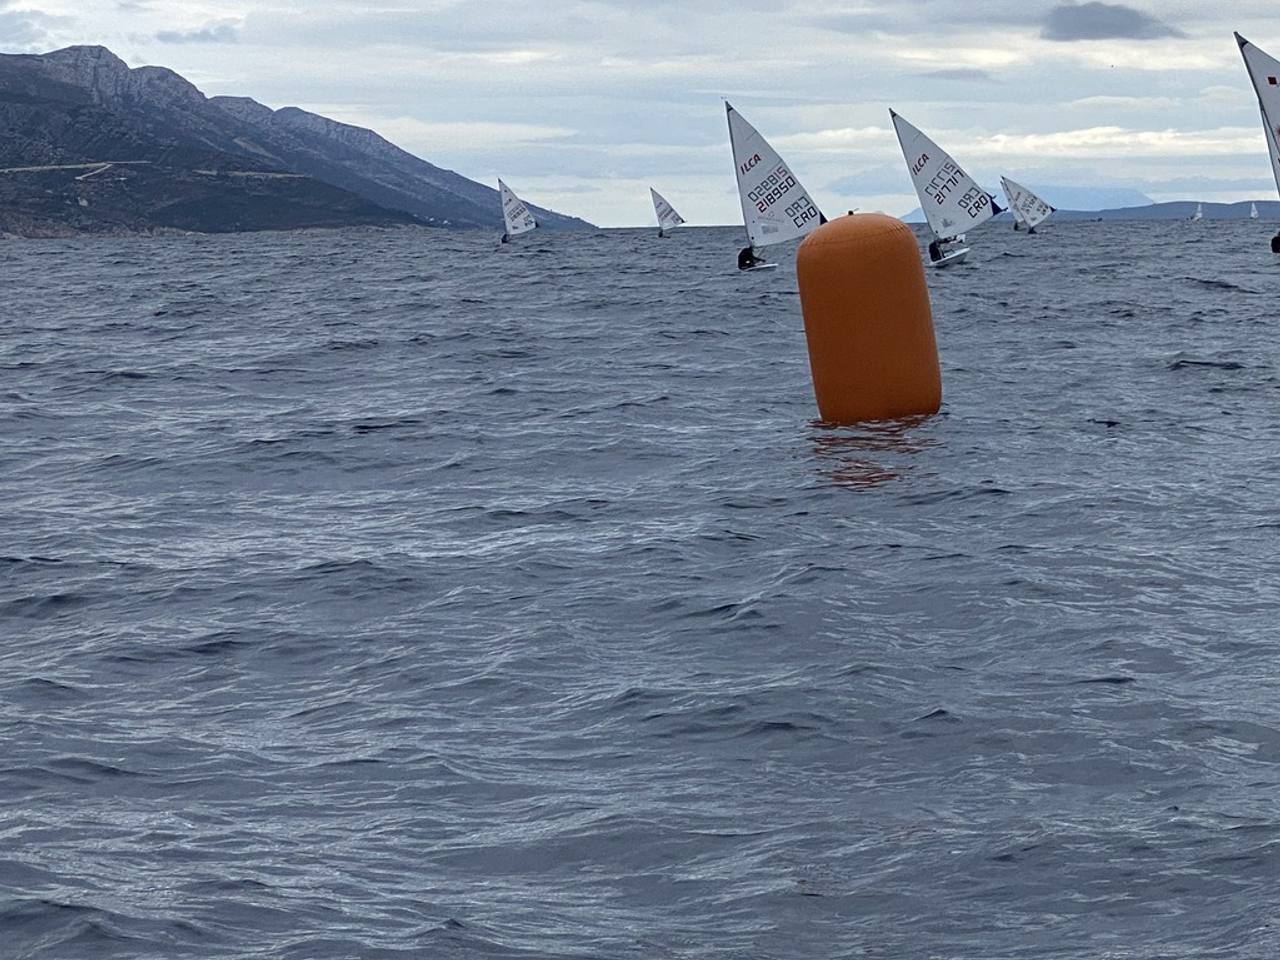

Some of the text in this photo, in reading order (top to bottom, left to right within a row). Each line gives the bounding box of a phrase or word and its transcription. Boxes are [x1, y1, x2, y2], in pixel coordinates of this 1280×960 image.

[741, 154, 762, 175] ILCA
[912, 153, 930, 175] ILCA
[756, 176, 796, 213] 218950
[934, 169, 964, 205] 217717
[793, 206, 818, 228] CRO
[967, 194, 989, 218] CRO
